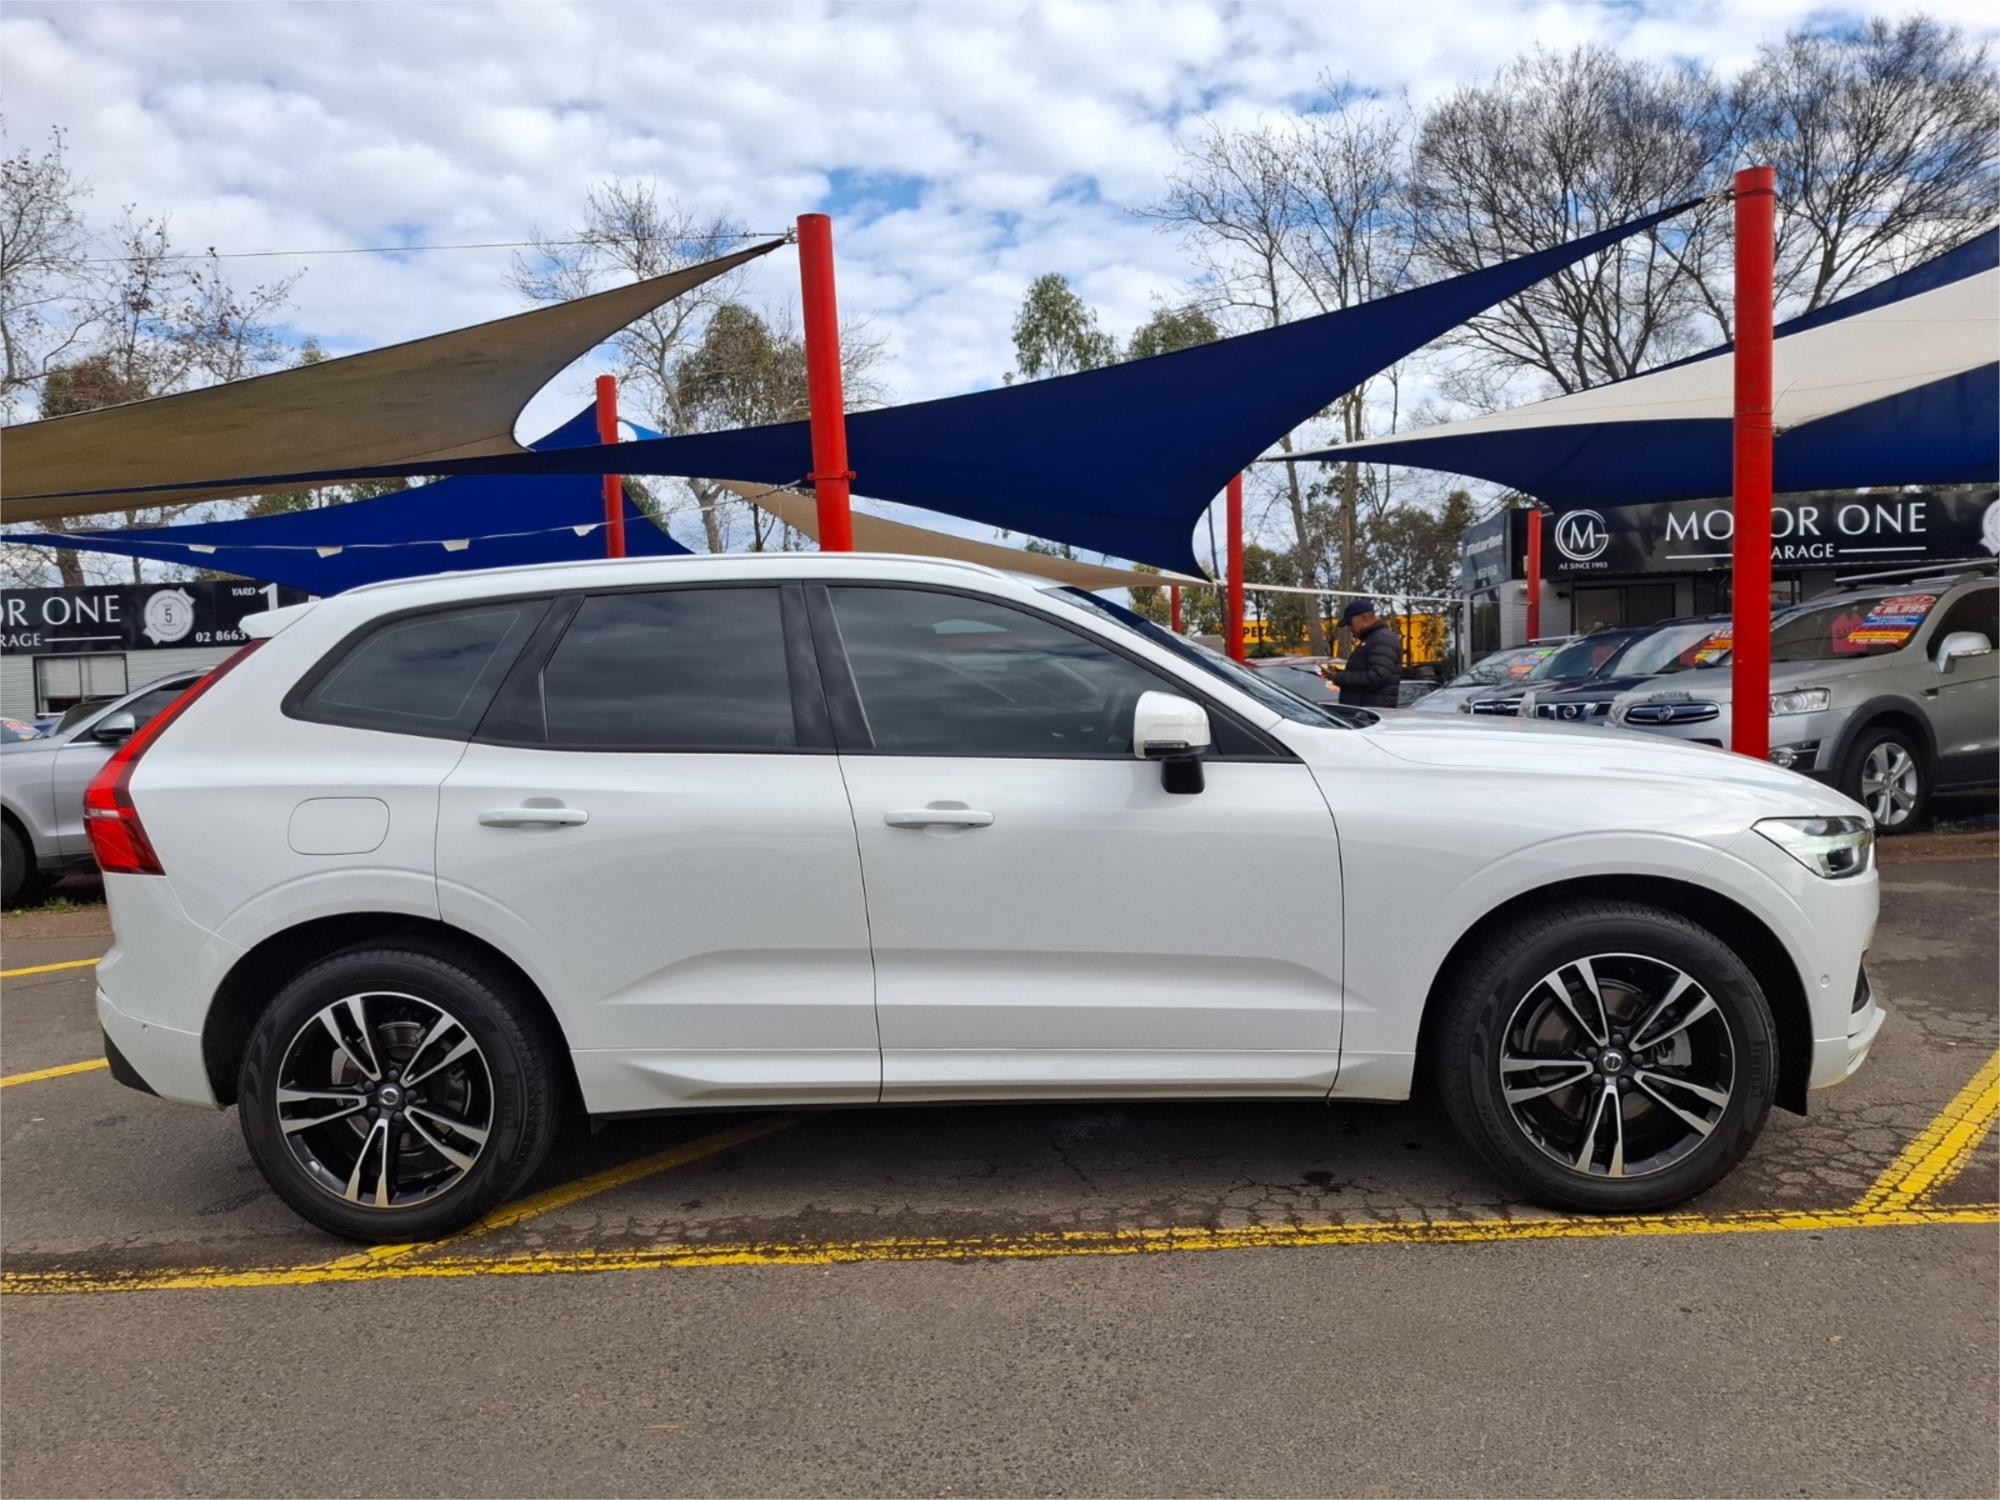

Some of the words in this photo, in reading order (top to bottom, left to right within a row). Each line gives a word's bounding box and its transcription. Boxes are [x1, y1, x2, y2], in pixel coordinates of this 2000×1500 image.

[1665, 506, 1821, 541] MOOR
[1838, 503, 1926, 535] ONE
[1770, 543, 1835, 560] ARAGE
[1569, 562, 1590, 570] SINCE
[231, 587, 256, 597] YARD
[258, 582, 279, 611] 1
[42, 595, 122, 626] ONE
[164, 608, 172, 624] 5
[195, 632, 211, 642] 02
[215, 630, 246, 641] 8663
